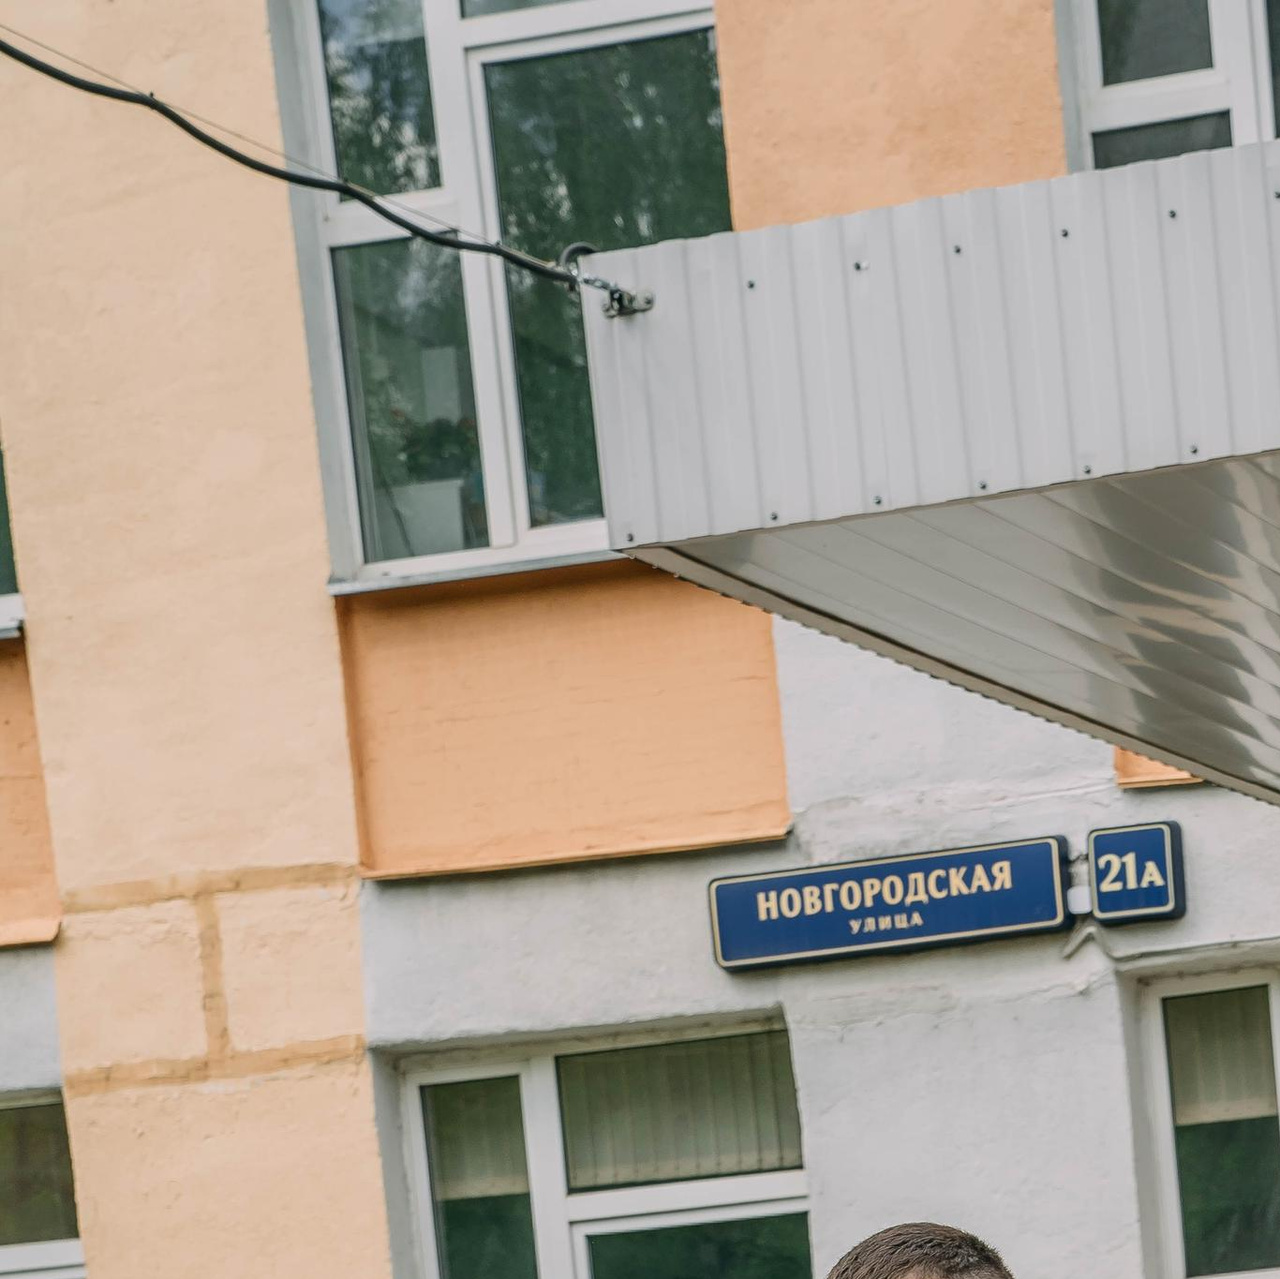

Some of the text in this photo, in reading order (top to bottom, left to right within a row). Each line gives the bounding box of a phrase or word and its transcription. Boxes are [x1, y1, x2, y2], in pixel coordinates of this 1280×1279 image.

[756, 852, 1165, 921] НОВГОРОДСКАЯ 21А
[849, 911, 924, 935] УЛИЦА
